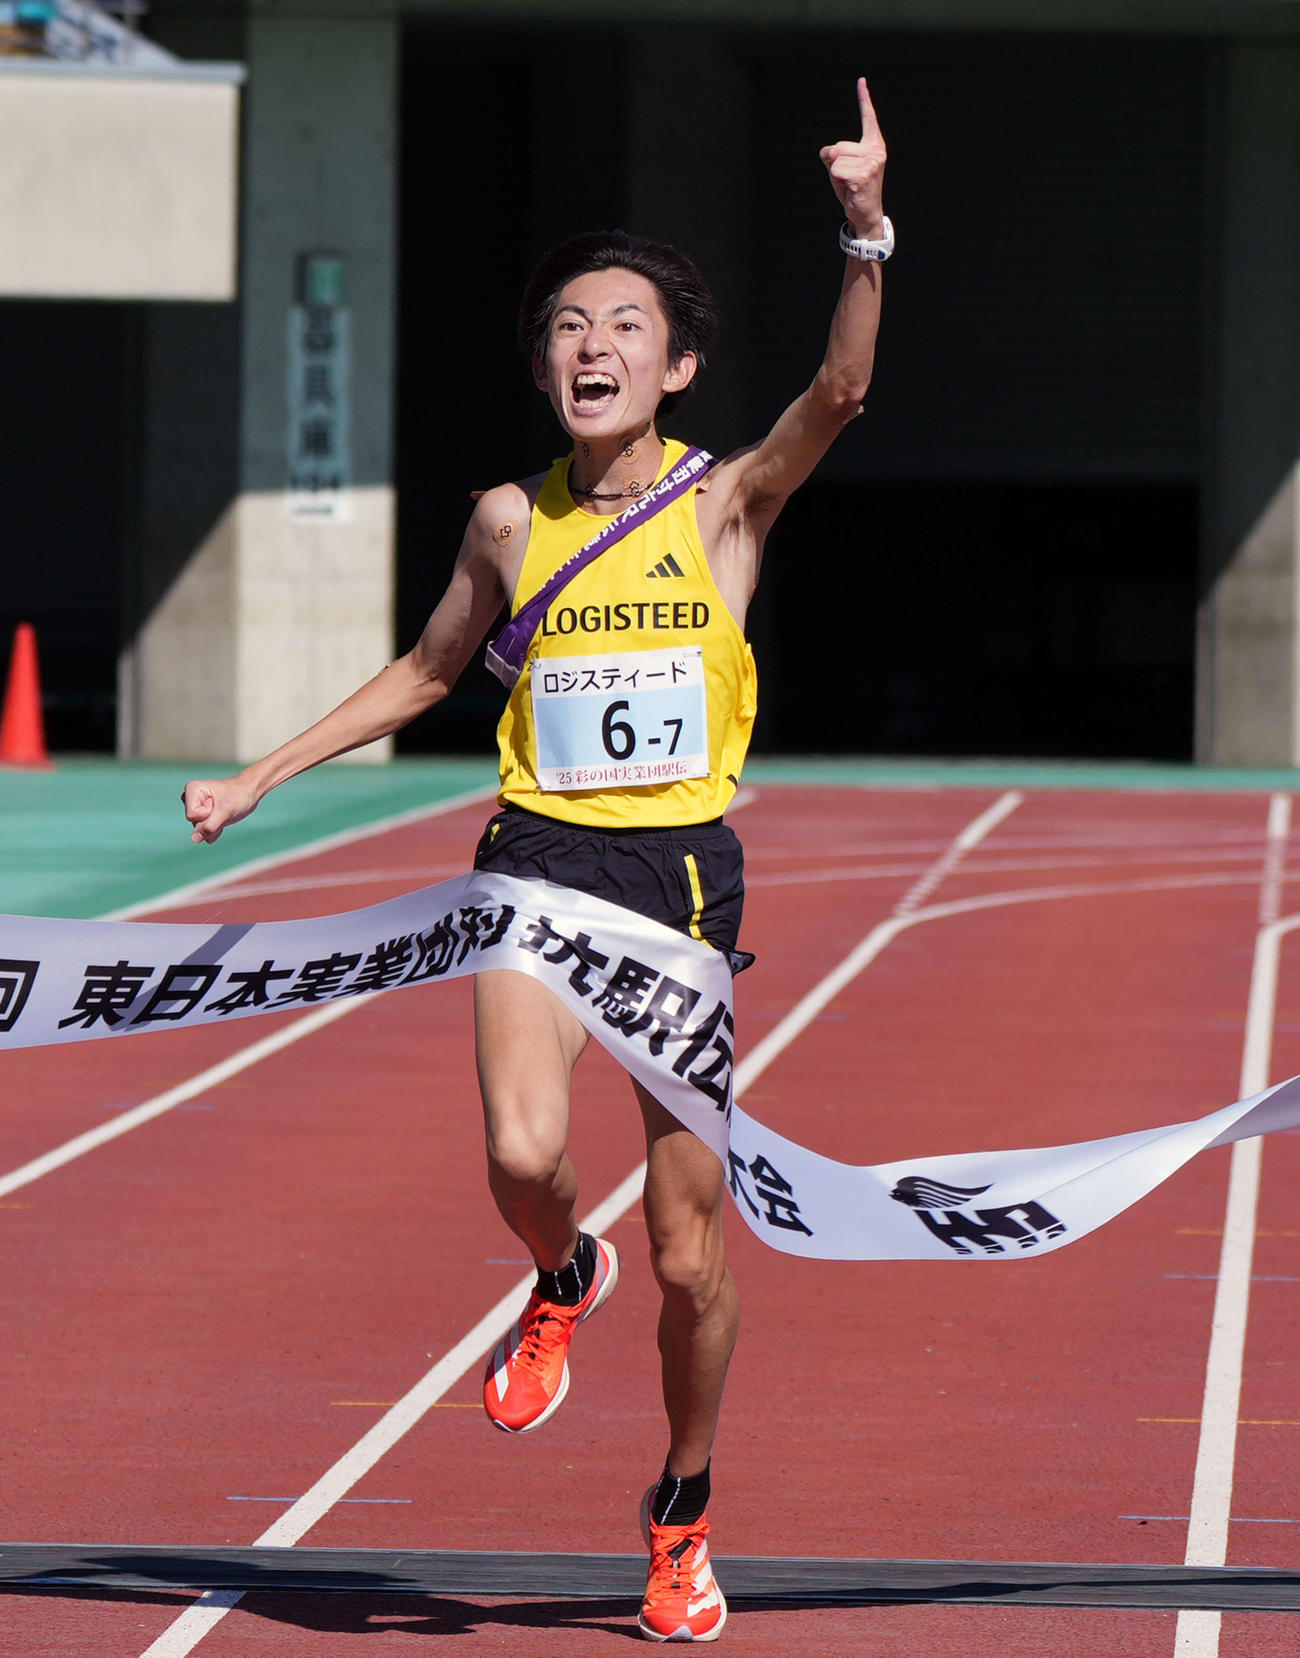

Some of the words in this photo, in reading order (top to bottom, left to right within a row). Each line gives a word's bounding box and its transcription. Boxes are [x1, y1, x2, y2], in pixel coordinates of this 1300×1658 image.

[542, 602, 710, 637] LOGISTEED
[544, 661, 687, 693] ロジスティード
